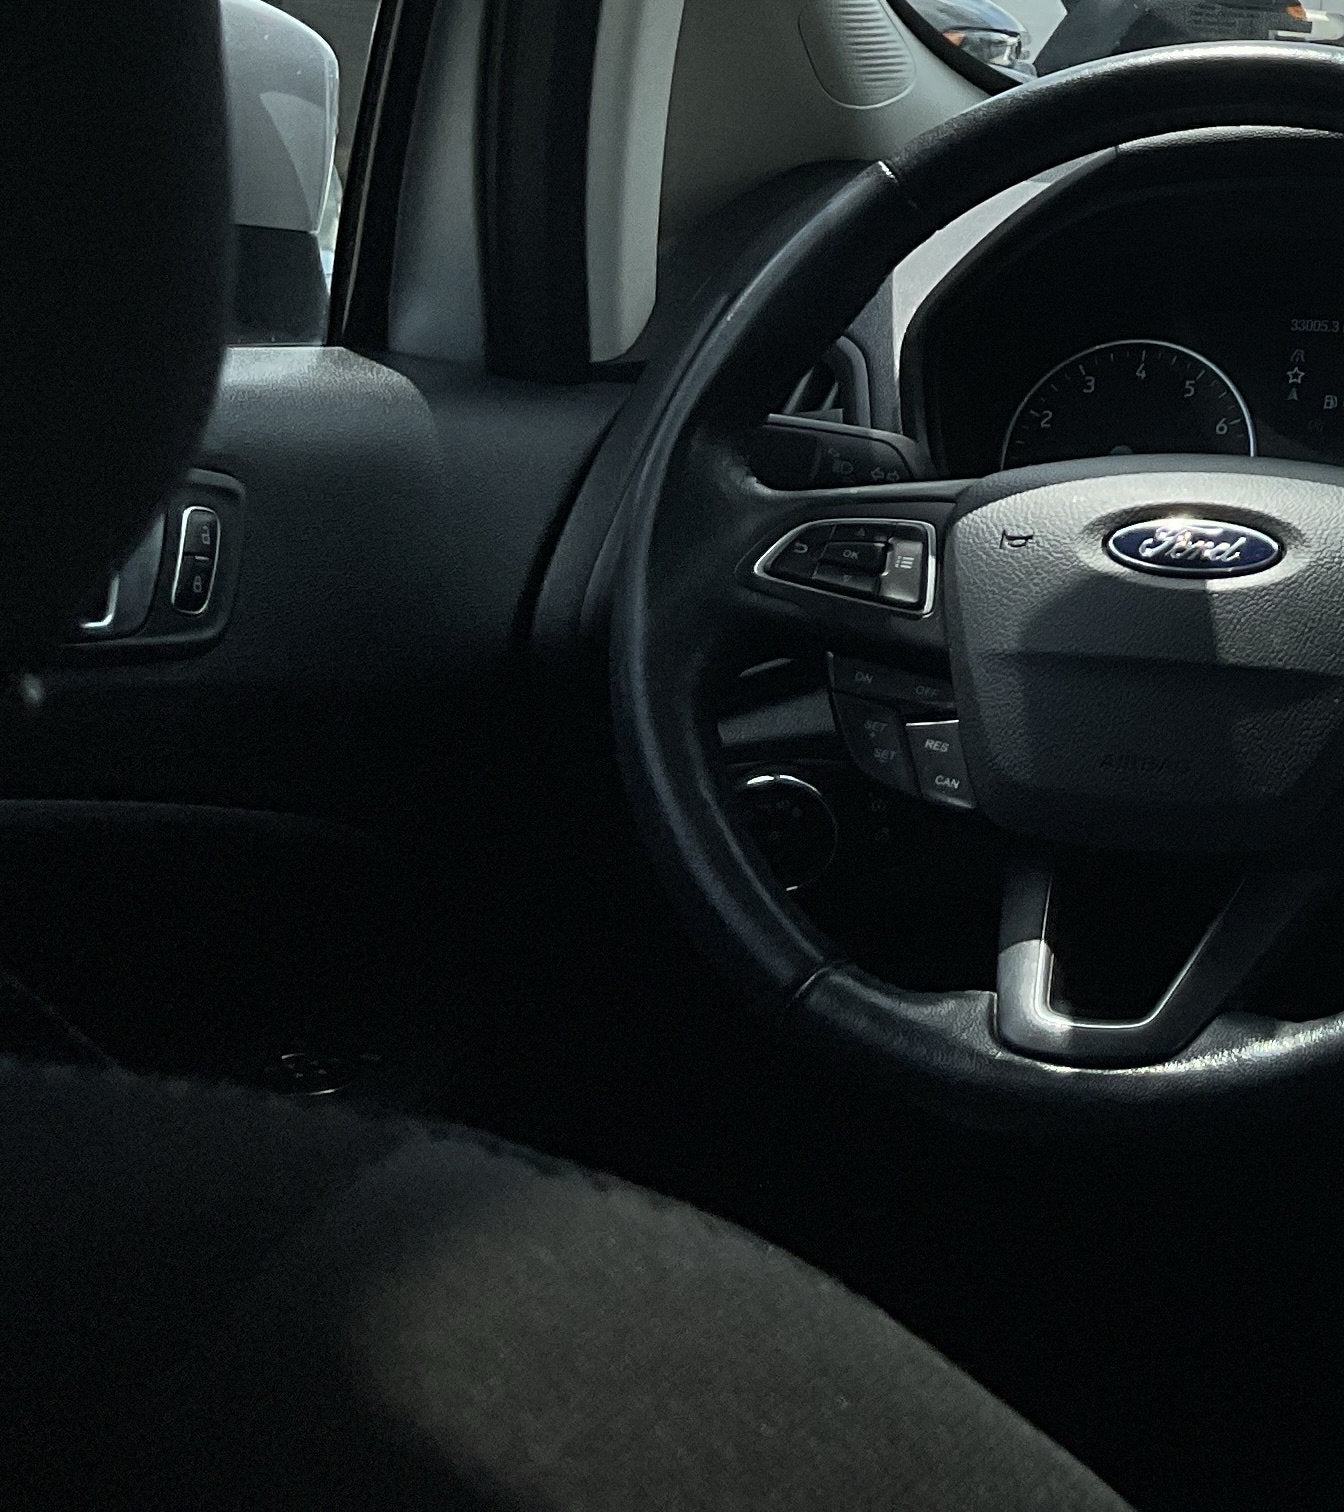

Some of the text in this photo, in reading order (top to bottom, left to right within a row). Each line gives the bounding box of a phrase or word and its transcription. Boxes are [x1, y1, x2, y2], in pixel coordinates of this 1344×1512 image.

[1135, 363, 1147, 379] 4
[1083, 376, 1096, 393] 3
[1184, 380, 1196, 398] 5
[1040, 410, 1053, 428] 2
[1215, 417, 1228, 435] 6
[1138, 524, 1247, 562] Ford
[843, 548, 859, 560] OK
[924, 738, 950, 753] RES
[935, 774, 960, 789] CAN
